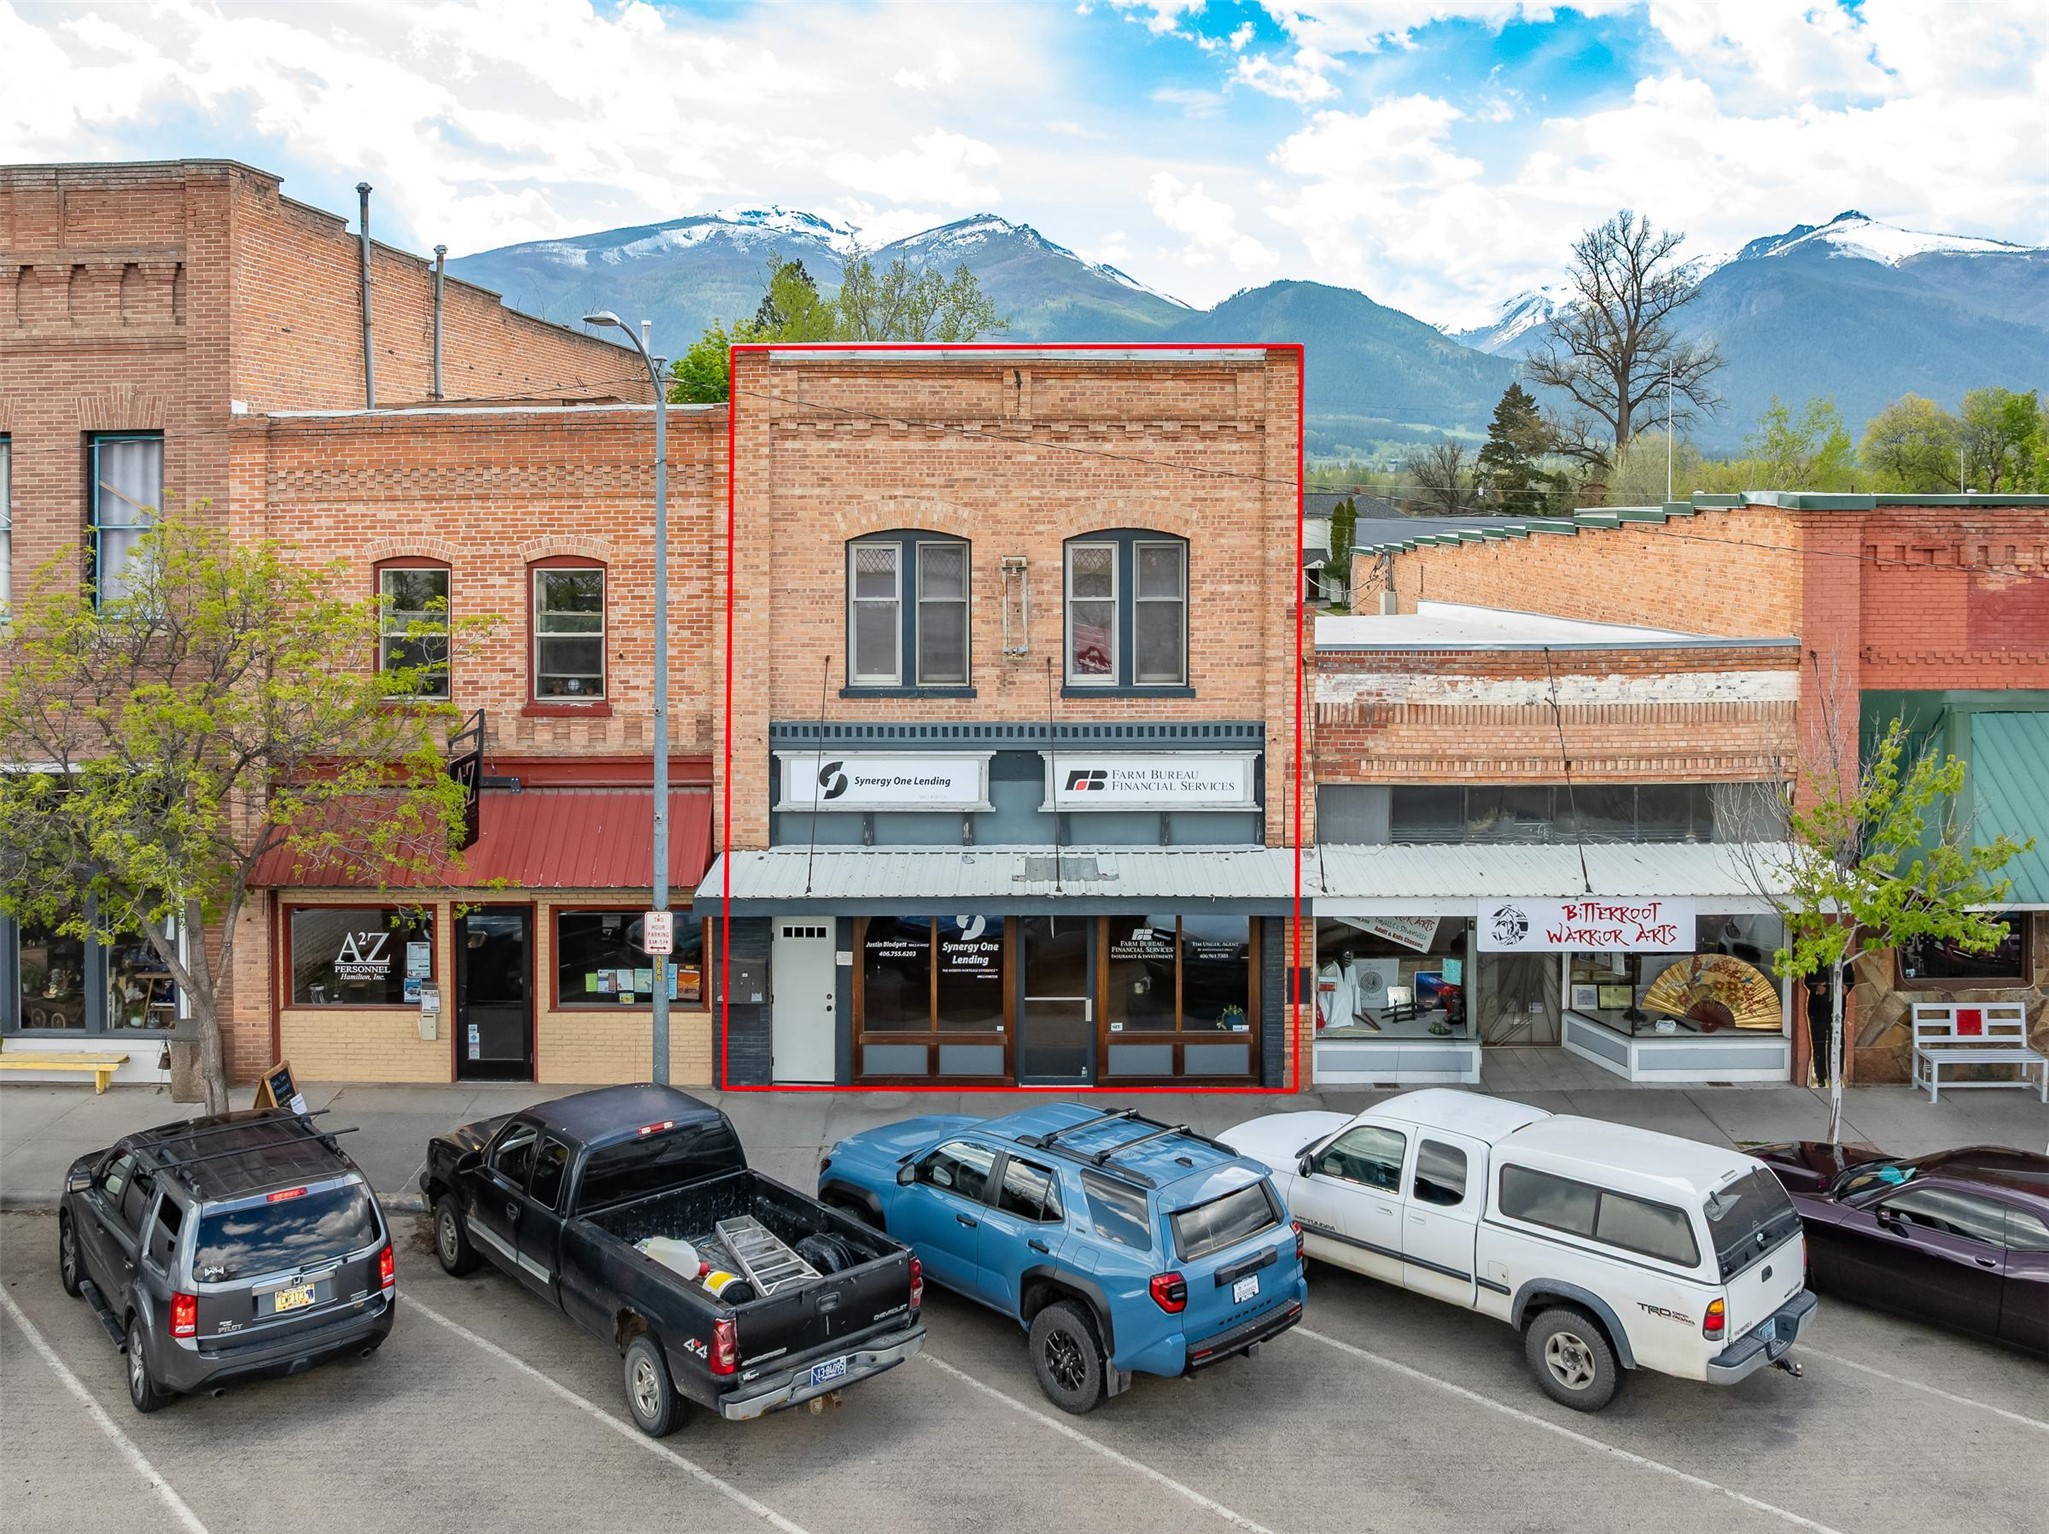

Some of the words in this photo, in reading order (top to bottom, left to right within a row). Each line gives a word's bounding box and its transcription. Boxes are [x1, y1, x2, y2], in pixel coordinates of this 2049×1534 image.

[1112, 770, 1146, 780] FARM
[1151, 770, 1199, 780] BUREAU
[854, 776, 891, 787] Synergy
[894, 776, 912, 785] One
[914, 776, 951, 788] Lending
[1112, 781, 1177, 791] FINANCIAL
[1181, 781, 1235, 791] SERVICES
[1635, 922, 1678, 946] ARTS
[942, 942, 979, 953] Synergy
[980, 942, 999, 951] One
[952, 955, 989, 966] Lending
[335, 965, 391, 973] PERSONNEL
[340, 973, 372, 981] Hamilton,
[1636, 1301, 1671, 1318] TRD
[218, 1323, 244, 1334] PILOT
